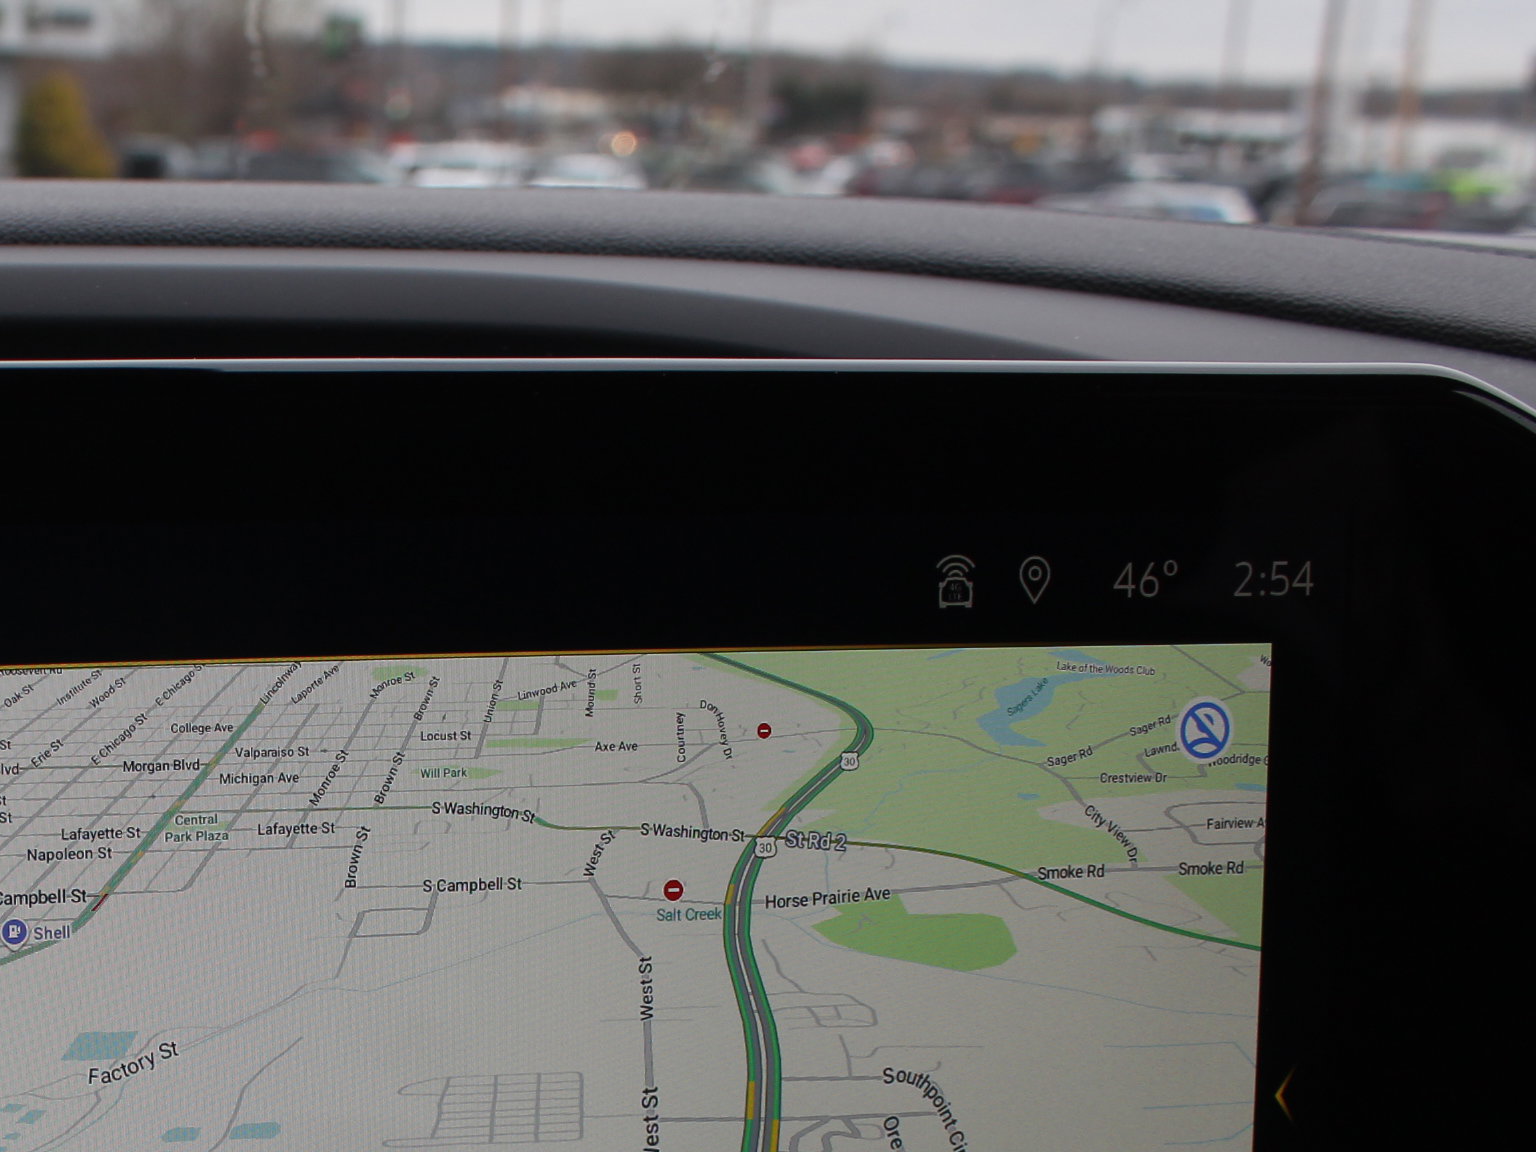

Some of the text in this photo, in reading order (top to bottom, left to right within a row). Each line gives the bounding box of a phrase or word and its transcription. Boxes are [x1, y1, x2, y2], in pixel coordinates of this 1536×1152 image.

[1233, 560, 1315, 597] 2:54
[1056, 661, 1155, 676] Lake of the Woods Club
[676, 712, 686, 763] Courtney
[700, 700, 732, 760] Don Hovey Dr
[0, 740, 11, 750] St
[91, 712, 148, 766] E Chicago St
[595, 742, 637, 752] Axe Ave
[844, 756, 855, 767] 30
[1046, 746, 1093, 767] Sager Rd
[219, 773, 299, 786] Michigan Ave
[309, 750, 349, 806] Monroe St
[421, 767, 467, 778] Will Park
[1100, 772, 1167, 783] Crestview Dr
[175, 814, 218, 826] Central
[61, 827, 140, 842] Lafayette St
[165, 830, 229, 842] Park Plaza
[640, 823, 745, 843] S Washington St
[786, 829, 846, 852] St Rd 2
[1085, 805, 1137, 863] City View Dr
[345, 826, 371, 888] Brown St
[759, 843, 772, 854] 30
[1179, 861, 1244, 876] Smoke Rd
[423, 877, 522, 894] S Campbell St
[70, 889, 87, 903] St
[765, 887, 891, 909] Horse Prairie Ave
[656, 907, 722, 921] Salt Creek
[34, 925, 70, 940] Shell
[88, 1041, 179, 1086] Factory St
[642, 1086, 658, 1109] St
[882, 1067, 958, 1130] Southpoint
[883, 1115, 902, 1151] Ore
